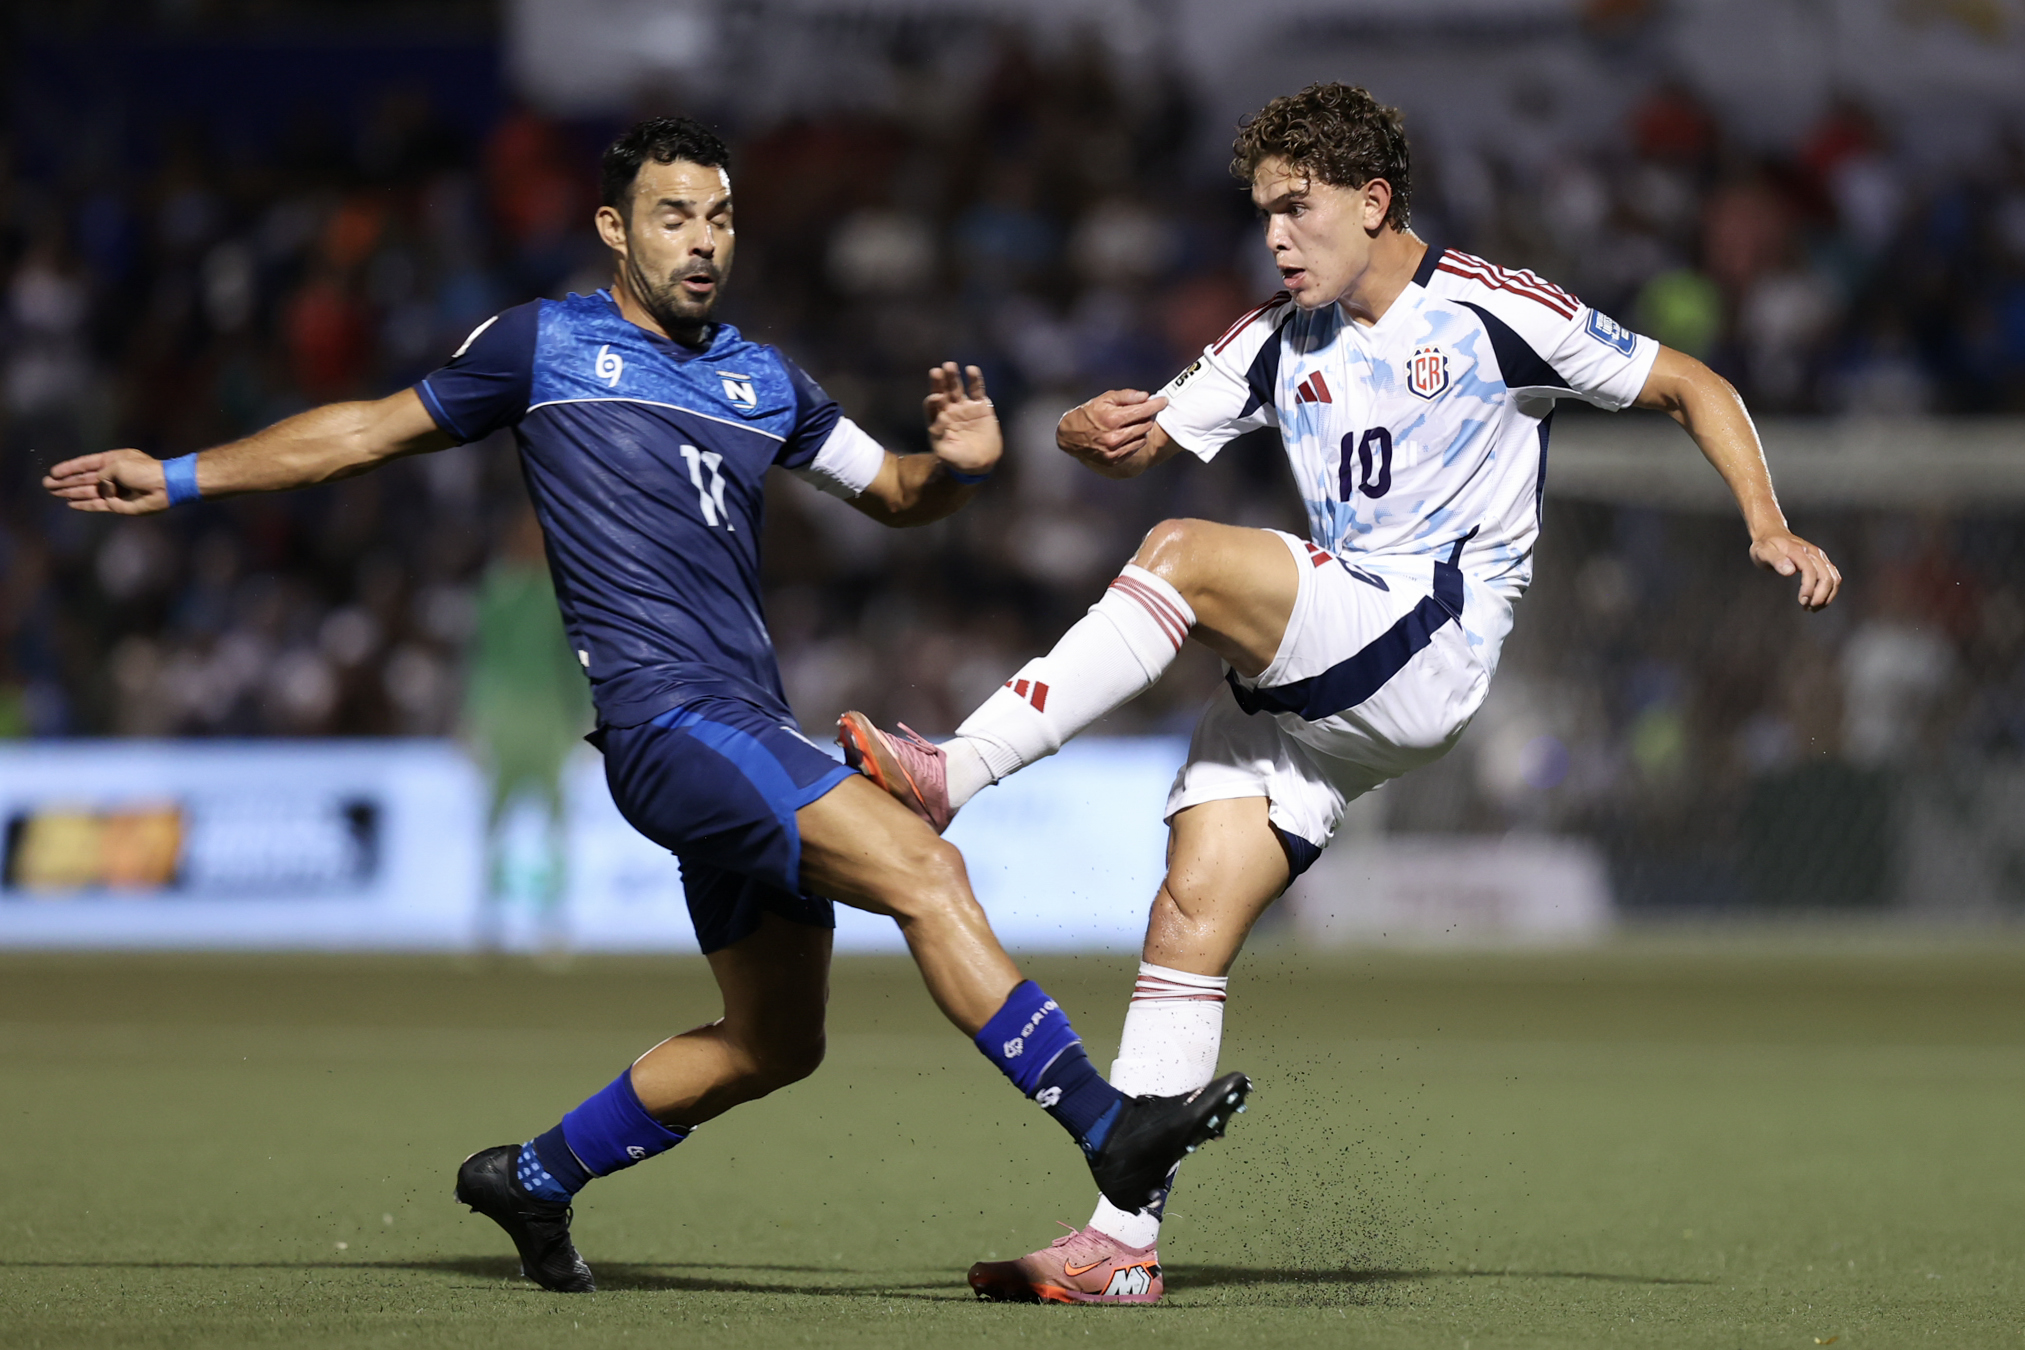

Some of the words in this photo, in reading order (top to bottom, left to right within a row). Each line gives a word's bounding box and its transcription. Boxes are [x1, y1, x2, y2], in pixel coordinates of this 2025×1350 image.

[1415, 356, 1441, 391] CR
[679, 445, 736, 532] 11
[1338, 426, 1392, 502] 10
